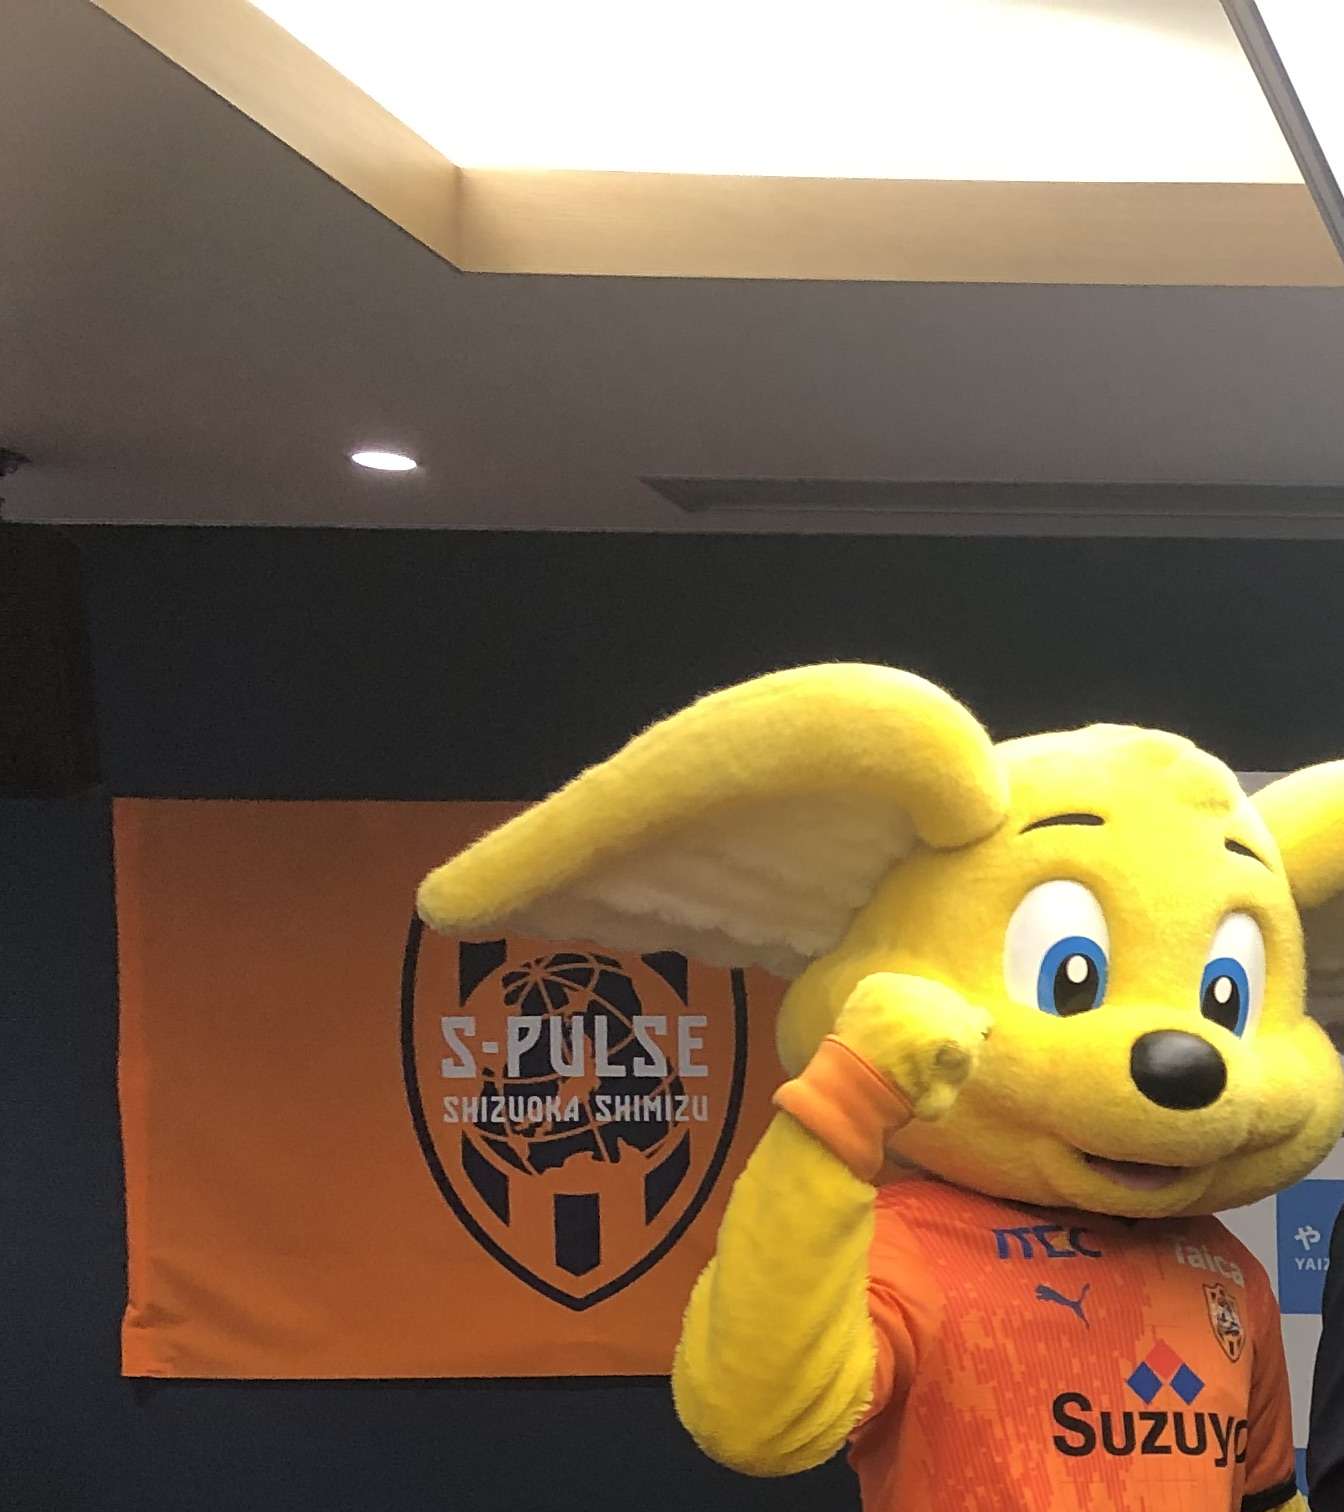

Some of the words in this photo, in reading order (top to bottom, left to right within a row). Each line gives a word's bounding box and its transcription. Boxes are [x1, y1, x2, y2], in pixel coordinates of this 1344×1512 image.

[440, 1014, 710, 1079] S-PULSE
[442, 1095, 580, 1124] SHIZUOKA
[594, 1095, 709, 1122] SHIMIZU
